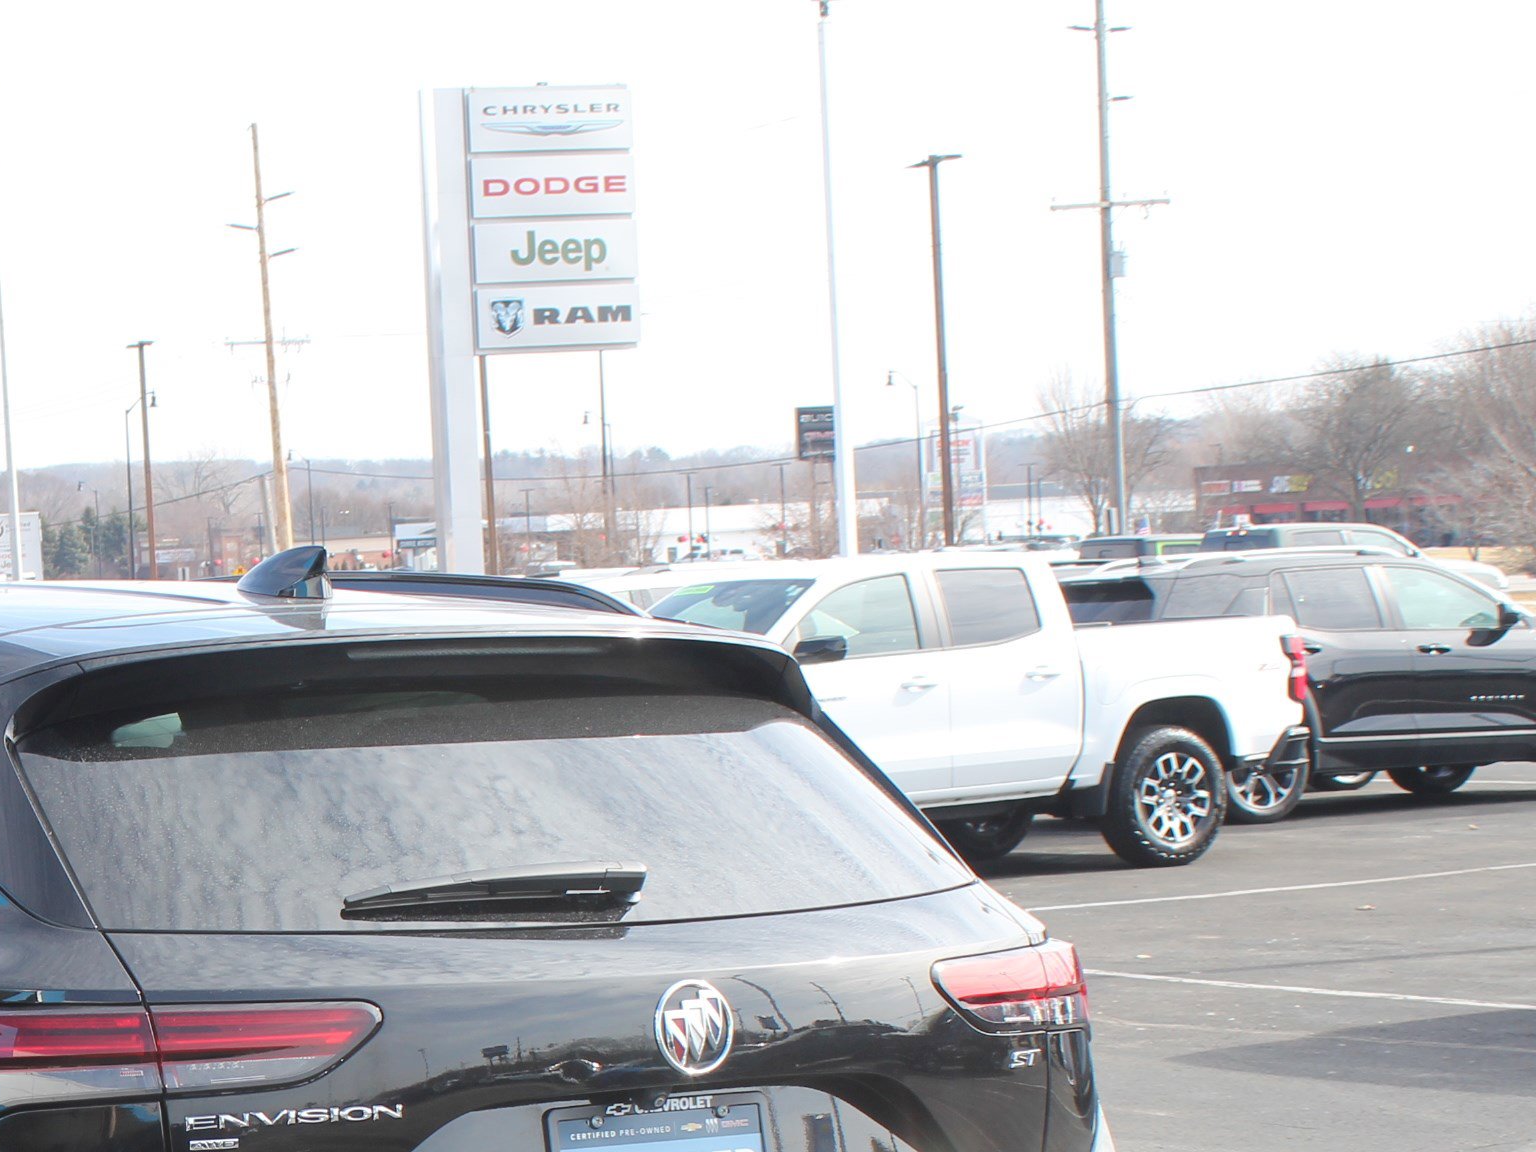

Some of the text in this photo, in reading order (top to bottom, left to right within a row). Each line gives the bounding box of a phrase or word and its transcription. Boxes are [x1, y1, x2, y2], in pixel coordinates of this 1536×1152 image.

[482, 103, 621, 116] CHRYSLER
[482, 175, 627, 197] DODGE
[510, 230, 607, 271] Jeep
[533, 305, 632, 325] RAM
[800, 413, 833, 422] BUIC
[185, 1103, 403, 1132] ENVISION
[570, 1125, 671, 1141] CERTIFIED PRE-OWNED
